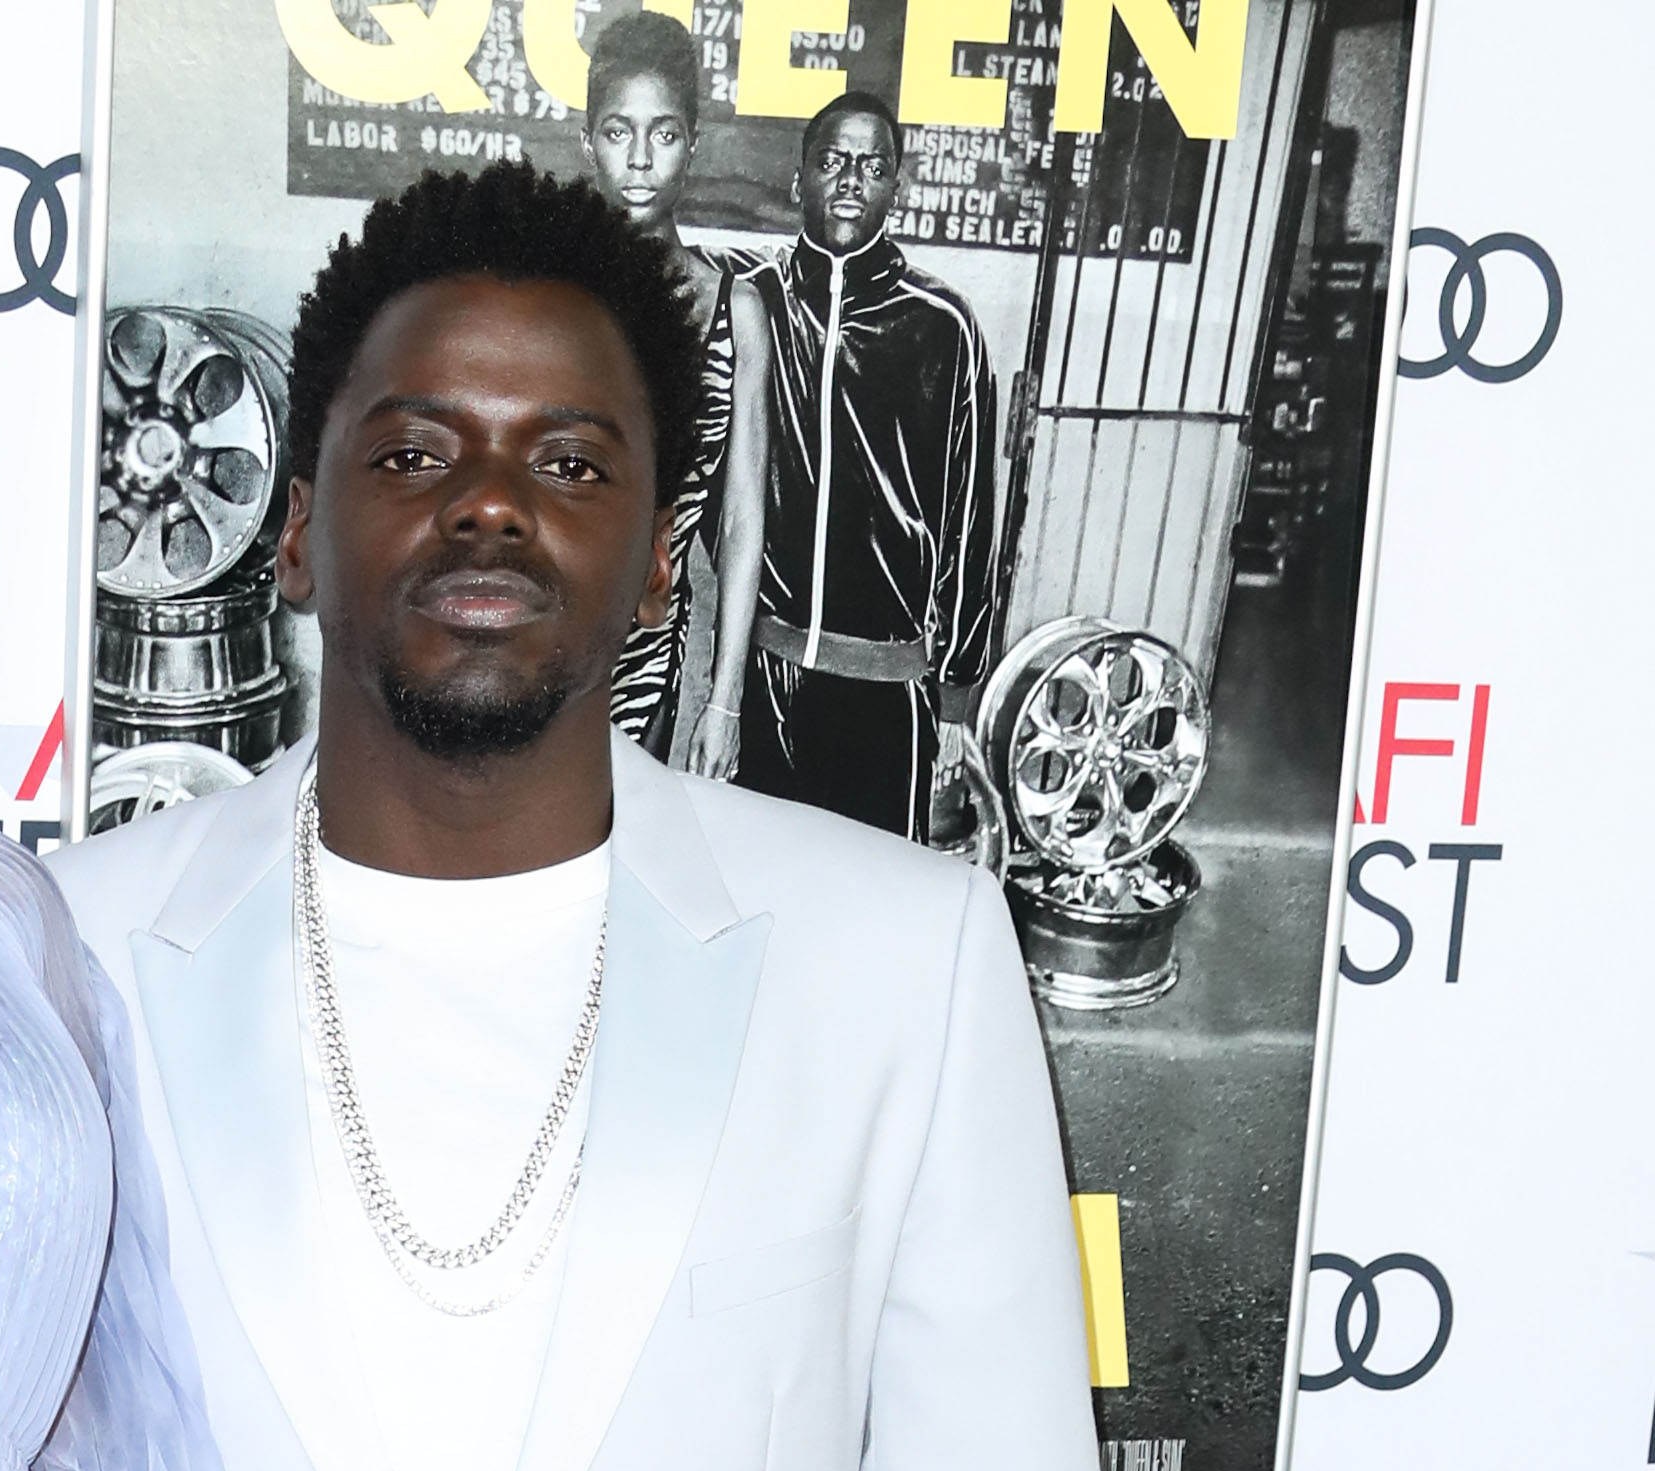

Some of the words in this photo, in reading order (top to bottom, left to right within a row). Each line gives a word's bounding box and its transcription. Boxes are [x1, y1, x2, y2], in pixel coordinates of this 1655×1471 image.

[306, 118, 398, 152] LABOR
[420, 125, 523, 162] $60/HR
[903, 128, 1010, 164] DISPOSAL
[917, 155, 978, 185] RIMS
[908, 184, 997, 217] SWITCH
[887, 210, 936, 239] EAD
[945, 215, 1044, 248] SEALER
[1353, 682, 1491, 826] FI
[1339, 839, 1503, 985] ST
